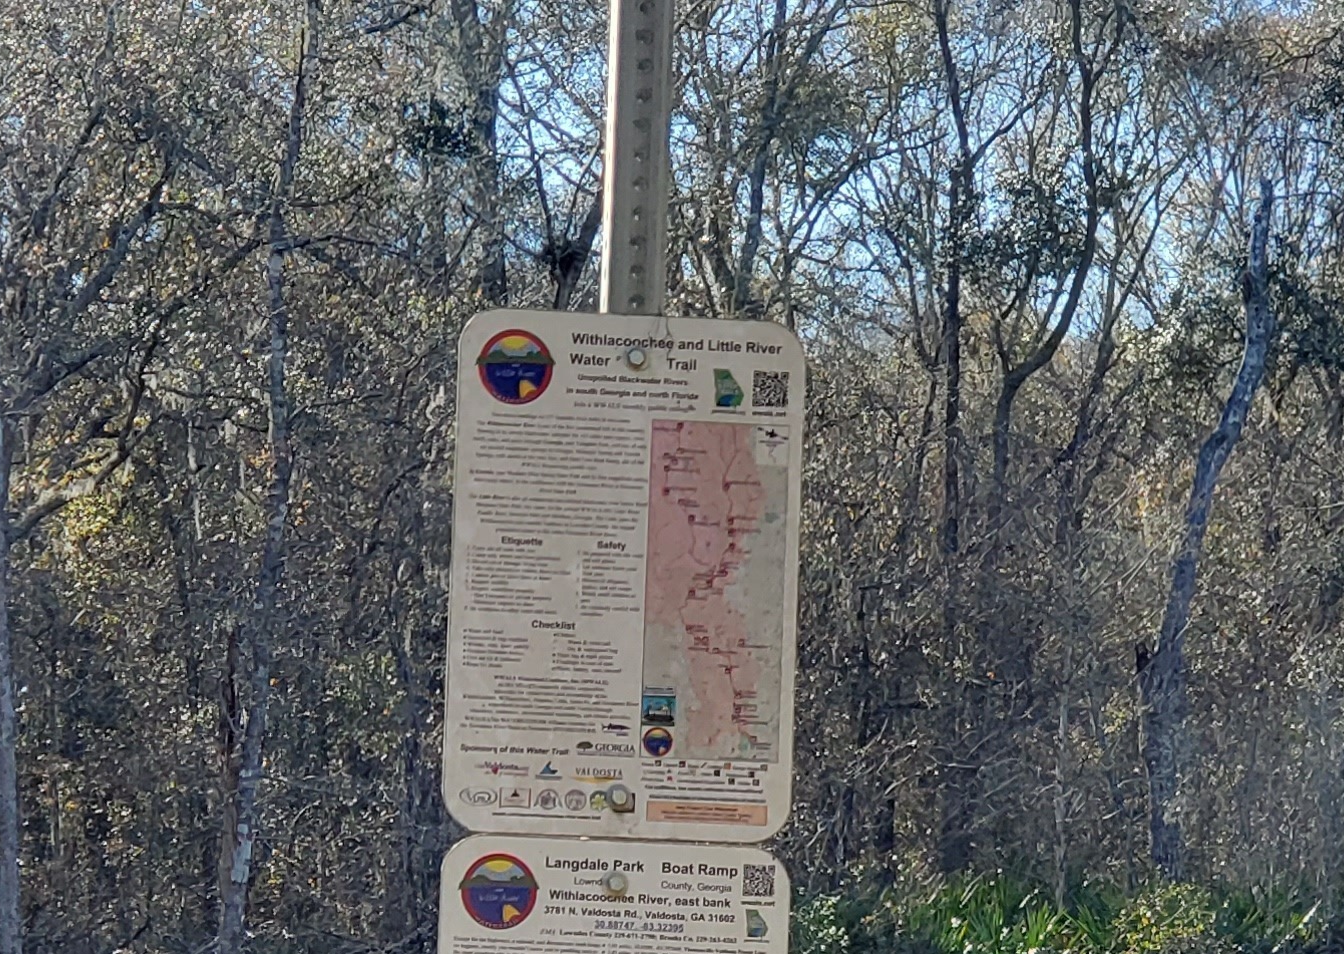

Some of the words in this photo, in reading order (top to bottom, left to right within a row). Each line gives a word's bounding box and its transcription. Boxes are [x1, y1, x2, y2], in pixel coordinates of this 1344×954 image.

[571, 332, 674, 349] Withlacoochee
[678, 339, 704, 350] and
[708, 340, 742, 353] Little
[746, 341, 783, 354] River
[570, 353, 611, 367] Water
[666, 358, 697, 370] Trail
[618, 375, 661, 384] Blackwater
[663, 378, 688, 386] Rivers
[599, 388, 631, 398] Georgia
[671, 392, 699, 400] Florida
[501, 536, 543, 547] Etiquette
[597, 540, 627, 552] Safety
[531, 619, 576, 630] Checklist
[509, 746, 525, 754] this
[526, 747, 550, 755] Water
[594, 743, 636, 752] GEORGIA
[545, 856, 609, 872] Langdale
[613, 859, 645, 872] Park
[661, 861, 694, 874] Boat
[698, 863, 739, 879] Ramp
[660, 881, 695, 892] County,
[697, 882, 732, 894] Georgia
[638, 894, 672, 907] River,
[674, 896, 700, 907] east
[702, 897, 731, 908] bank
[544, 905, 566, 915] 3781
[568, 907, 578, 915] N.
[581, 907, 621, 918] Valdosta
[644, 911, 688, 922] Valdosta,
[690, 913, 706, 922] GA
[707, 913, 736, 923] 31602
